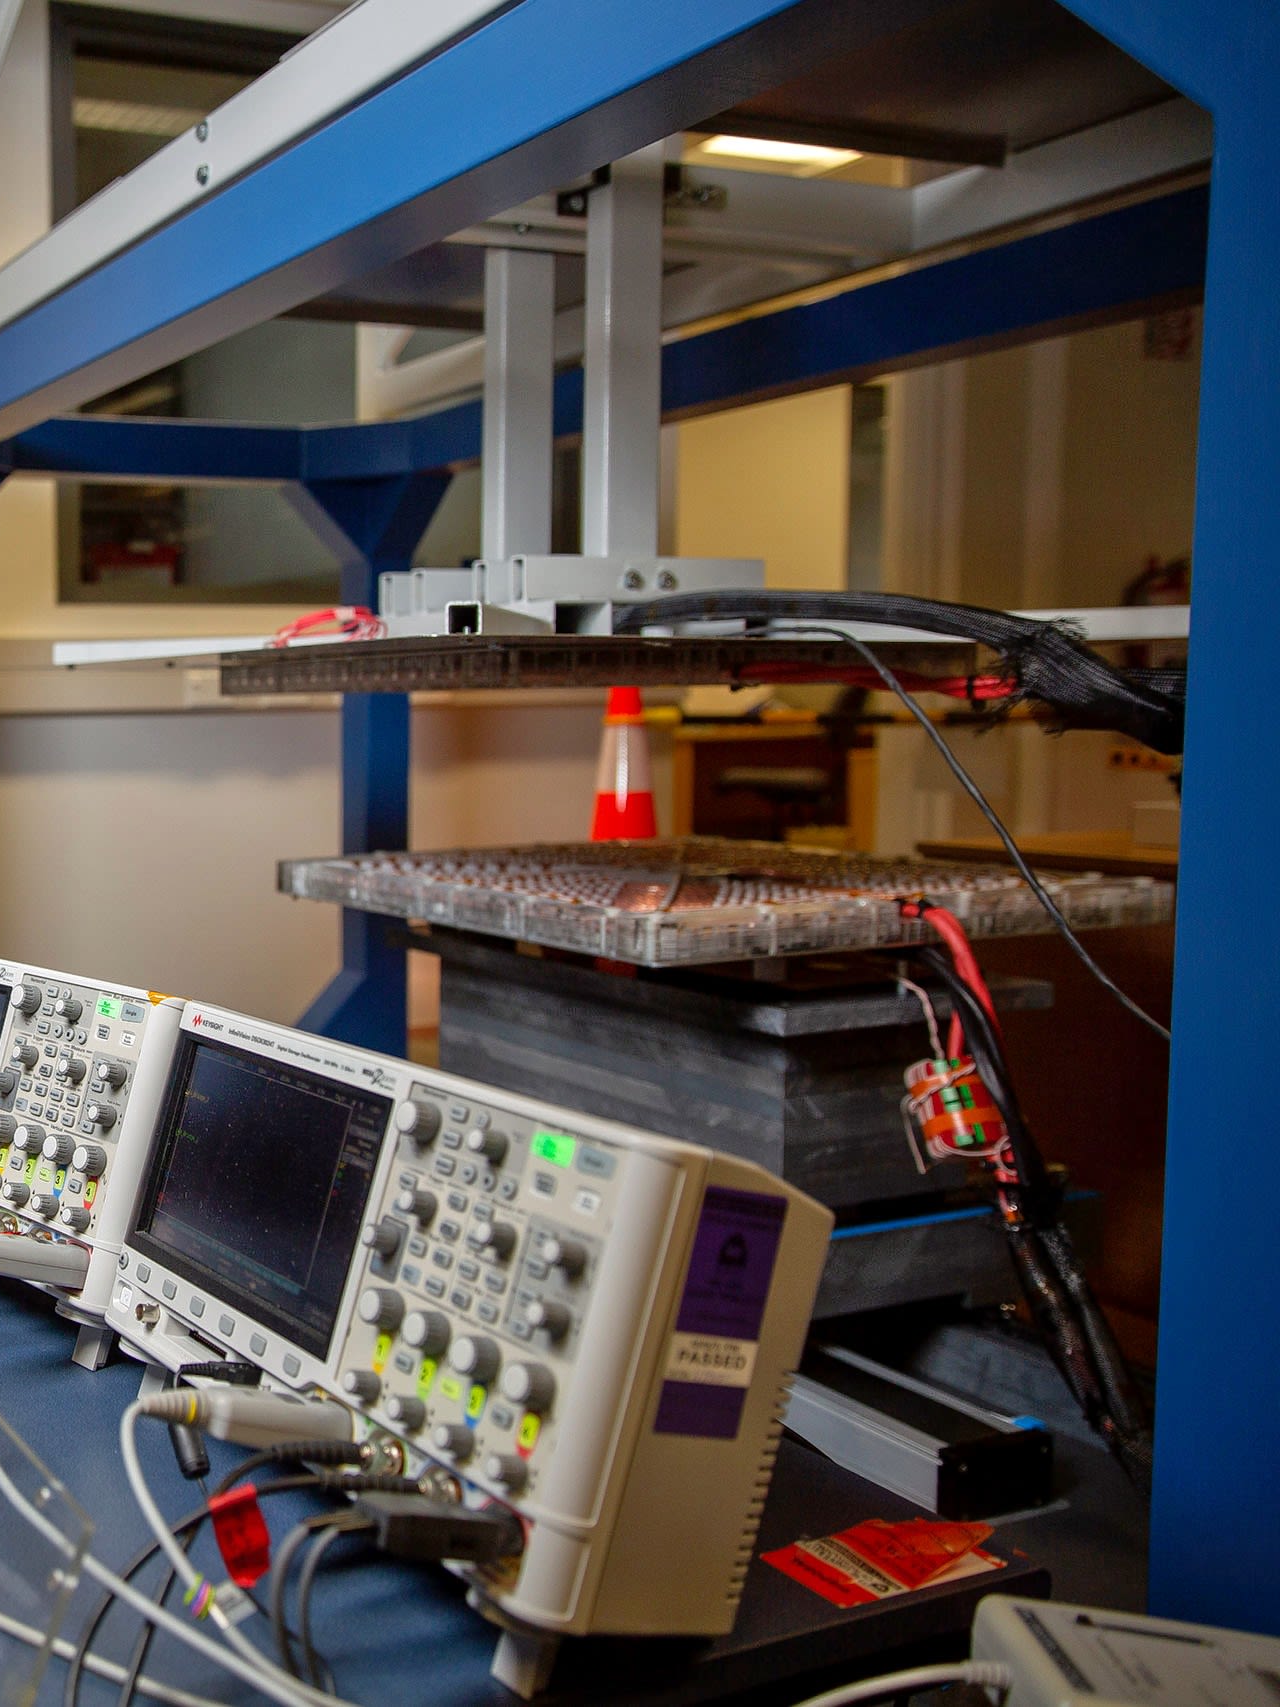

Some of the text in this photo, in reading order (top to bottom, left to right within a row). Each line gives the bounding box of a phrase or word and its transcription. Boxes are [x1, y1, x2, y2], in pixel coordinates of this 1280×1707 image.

[202, 1019, 224, 1032] KEYSIGHT
[25, 1164, 31, 1173] 2
[55, 1175, 61, 1184] 3
[85, 1187, 91, 1197] 4
[678, 1349, 748, 1371] PASSED
[420, 1367, 429, 1381] 2
